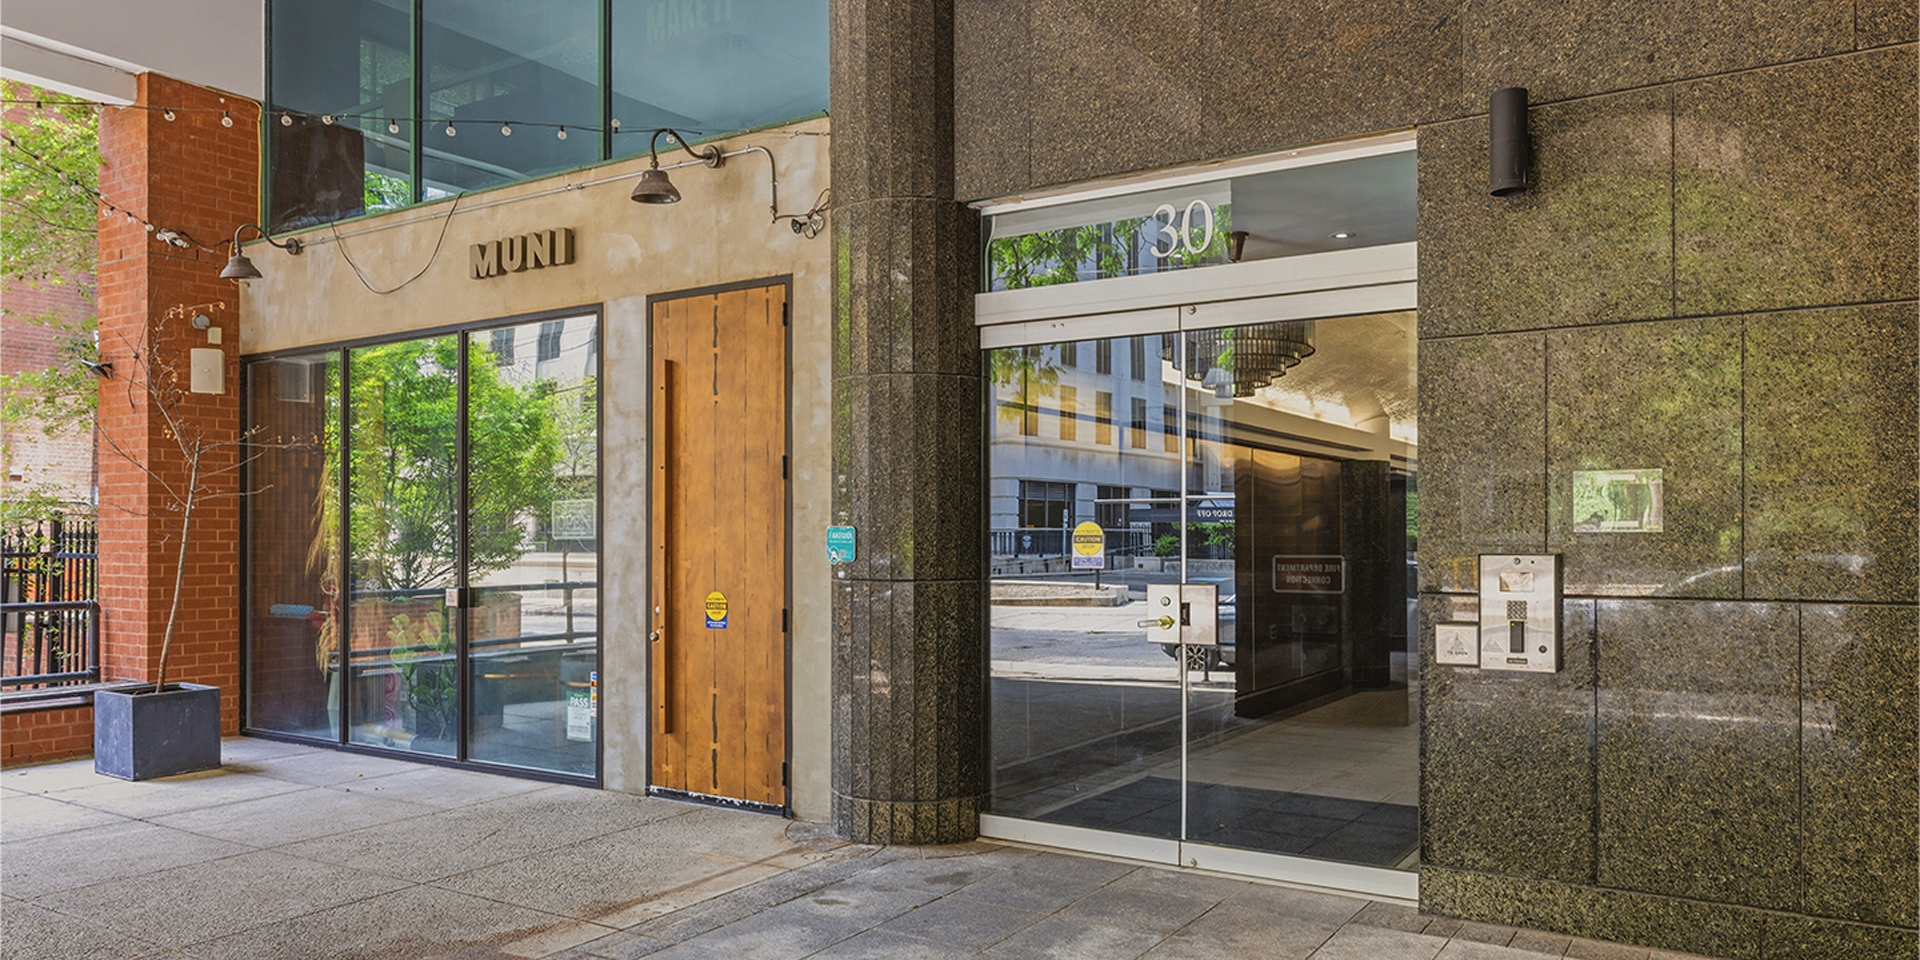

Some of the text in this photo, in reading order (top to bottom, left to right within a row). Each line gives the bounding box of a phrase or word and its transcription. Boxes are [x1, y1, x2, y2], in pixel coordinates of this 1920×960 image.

[646, 0, 708, 46] MAKE
[1150, 199, 1214, 258] 30
[469, 227, 575, 281] MUNI
[570, 696, 589, 708] PASS
